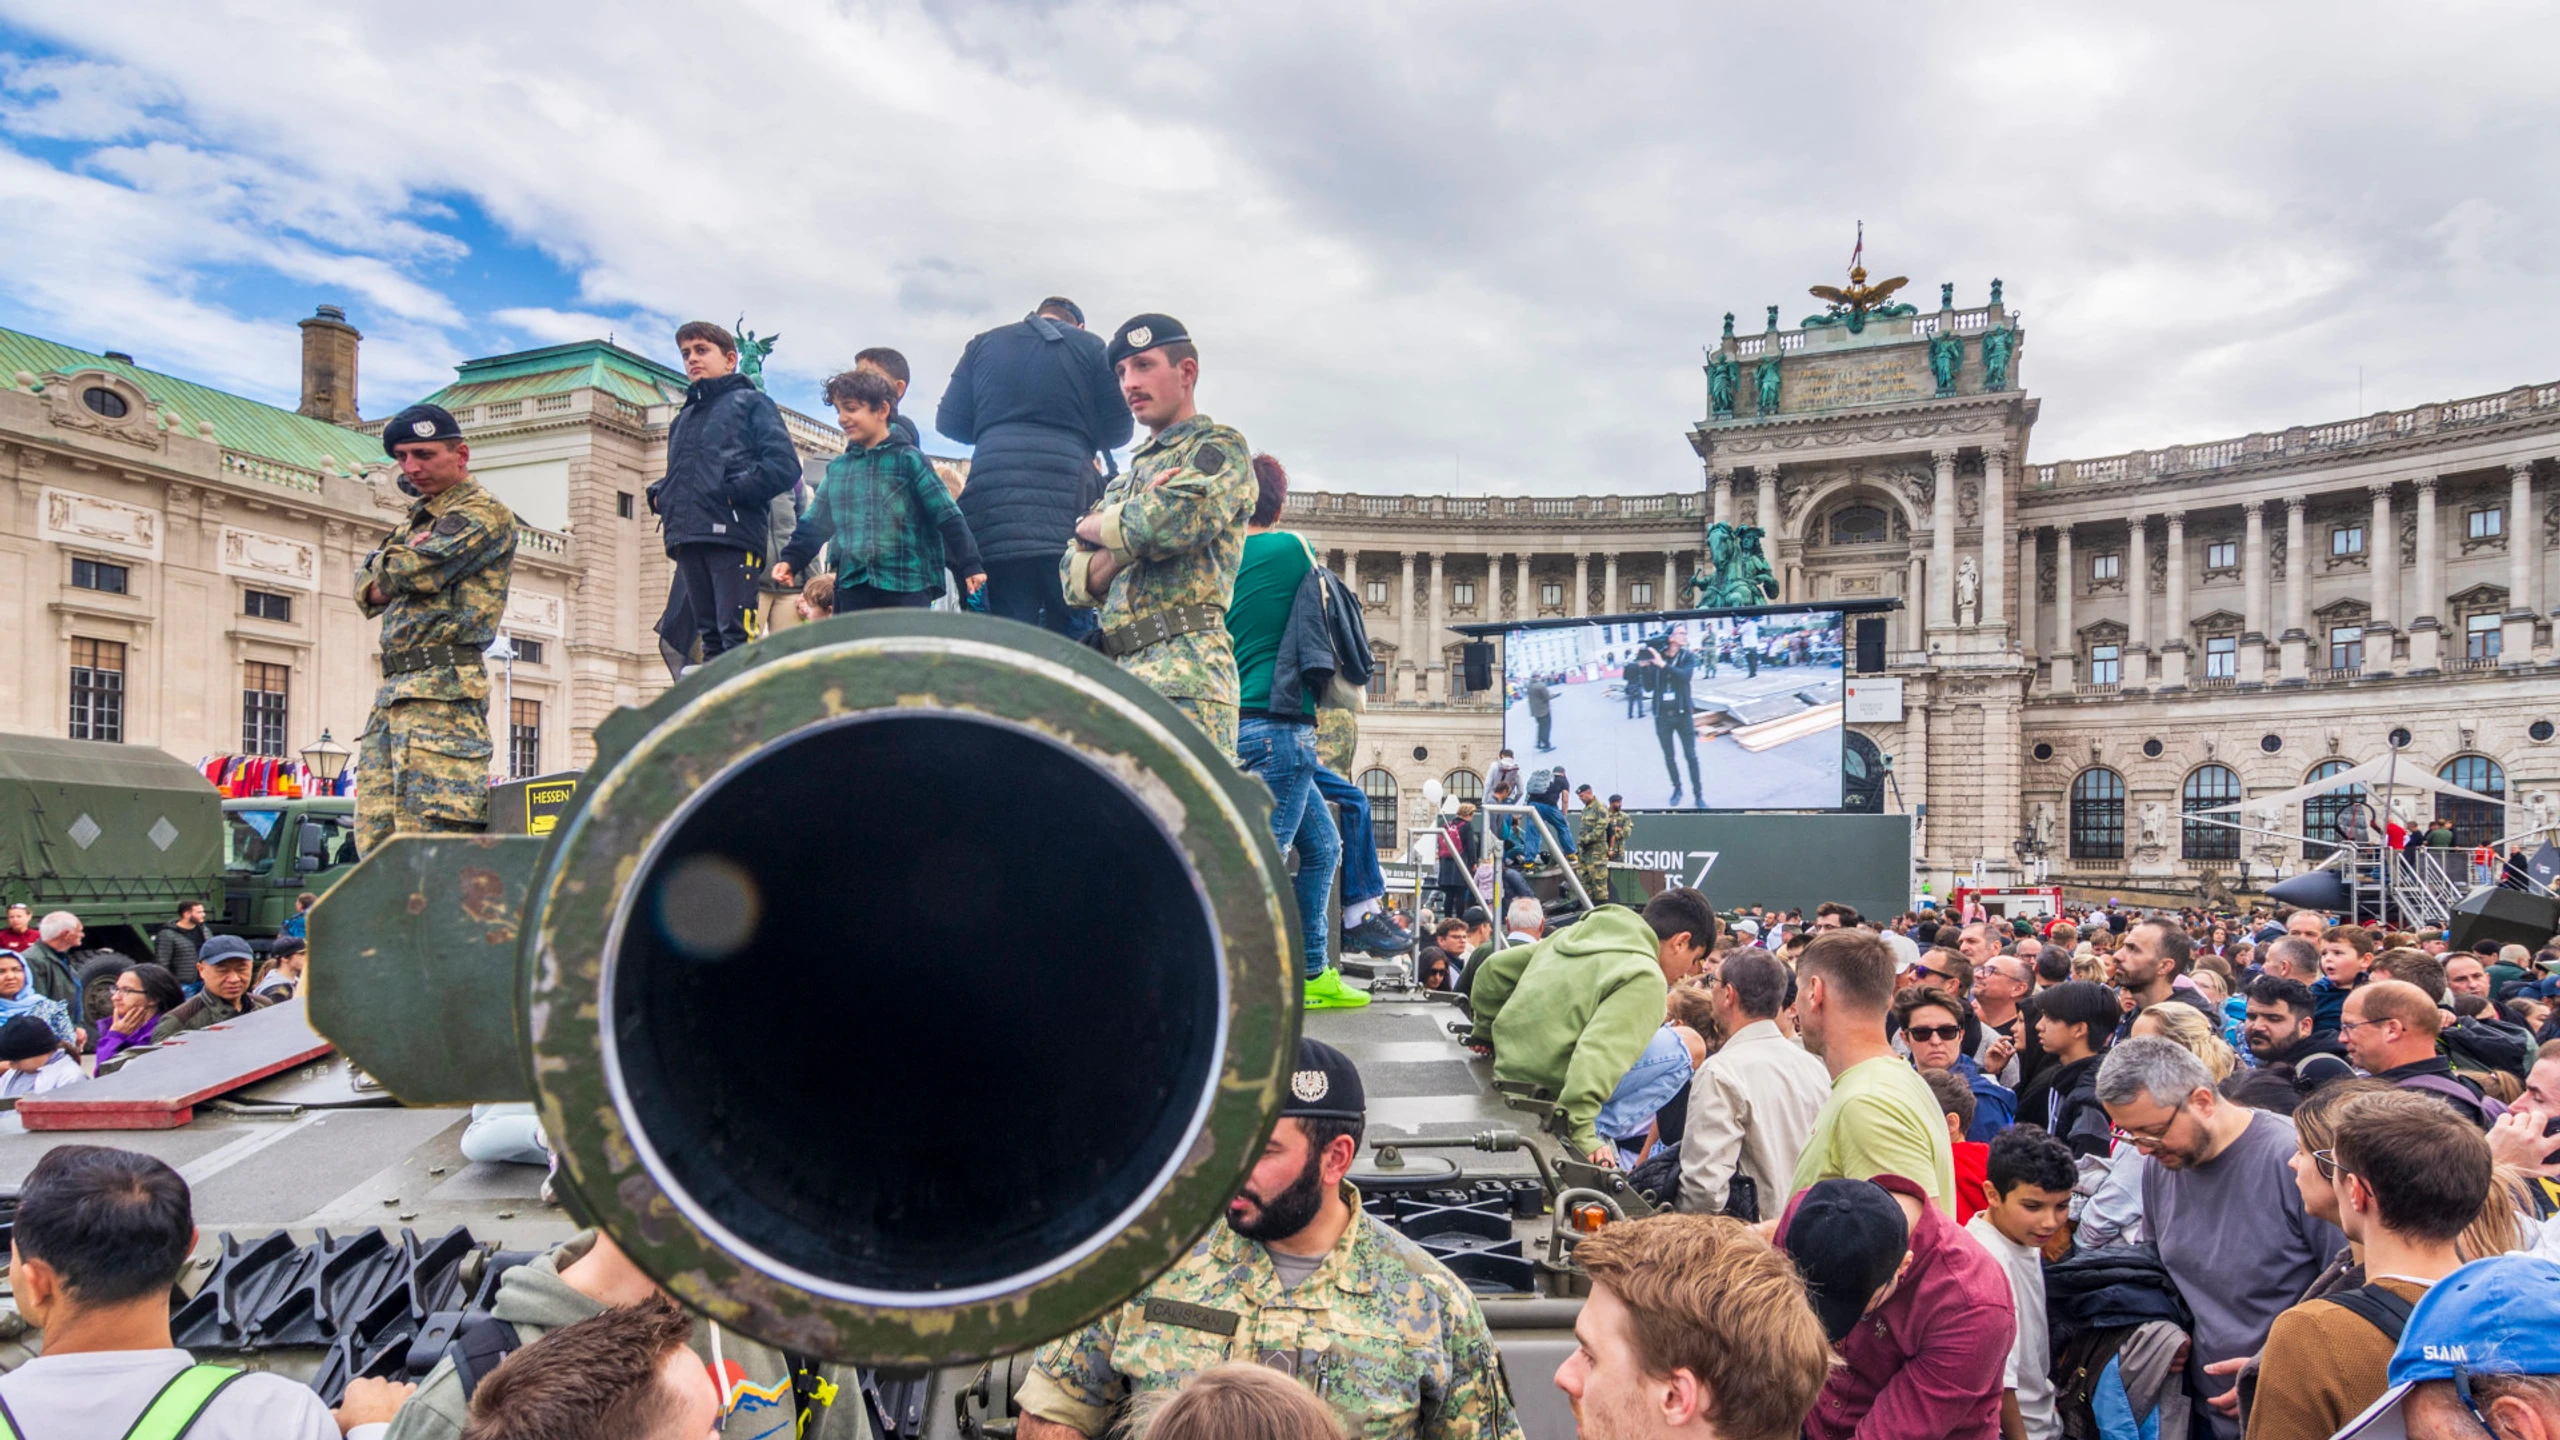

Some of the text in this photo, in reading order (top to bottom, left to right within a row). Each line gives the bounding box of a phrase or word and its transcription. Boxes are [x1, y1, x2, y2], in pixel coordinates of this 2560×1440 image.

[533, 789, 570, 804] HESSEN
[1664, 873, 1684, 890] TS
[1153, 1303, 1219, 1327] CALISKAN
[2422, 1344, 2468, 1361] SLAM
